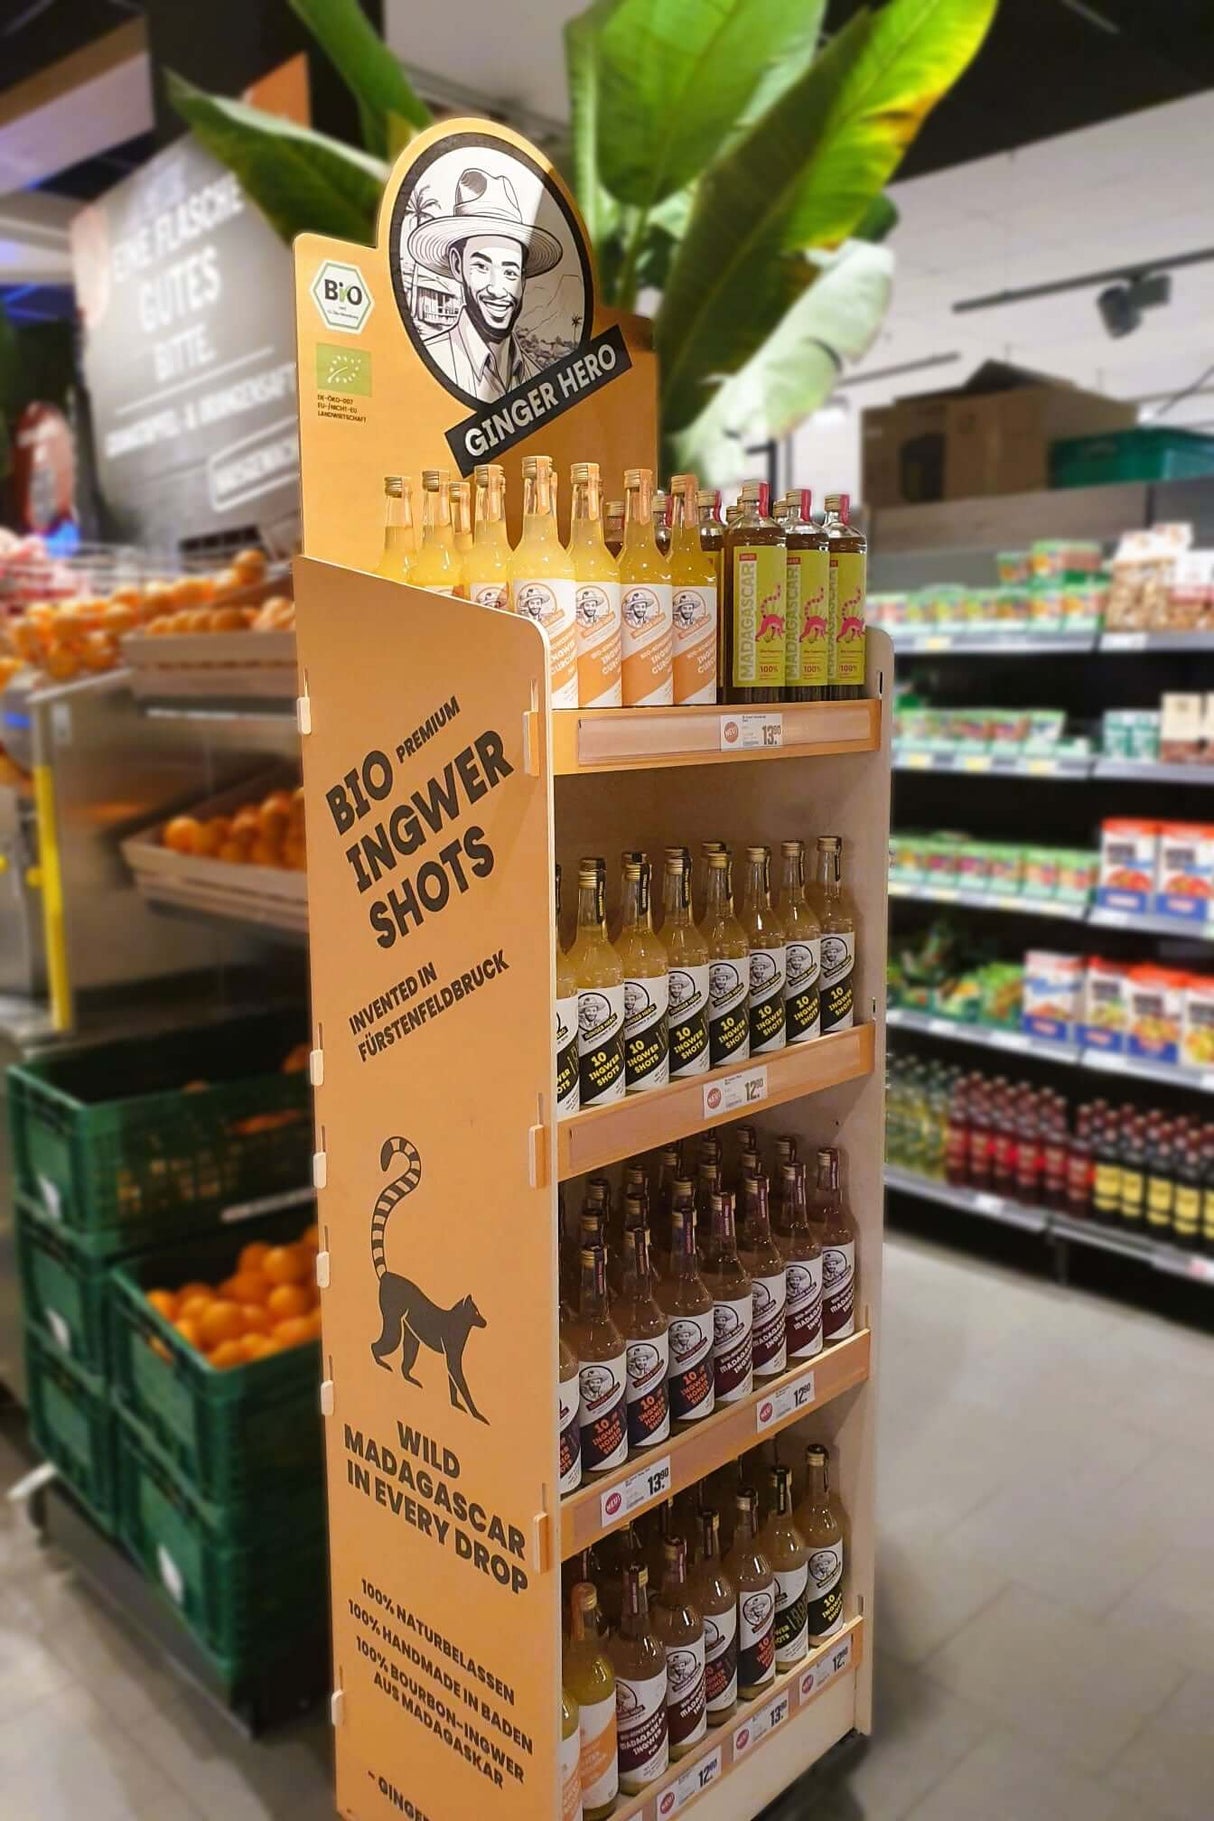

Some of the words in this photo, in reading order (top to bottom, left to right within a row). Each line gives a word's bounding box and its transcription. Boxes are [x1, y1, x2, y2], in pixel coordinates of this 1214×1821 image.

[464, 382, 559, 456] GINGER
[556, 343, 617, 399] HERO
[317, 411, 367, 423] LANDWIRTSCHAFT
[741, 563, 754, 678] MADAGASCAR
[760, 665, 778, 673] 100%
[325, 750, 394, 835] BIO
[396, 695, 460, 763] PREMIUM
[346, 730, 515, 894] INGWER
[370, 826, 495, 949] SHOTS
[349, 976, 418, 1035] INVENTED
[417, 962, 438, 989] IN
[796, 996, 809, 1009] 10
[830, 986, 844, 999] 10
[357, 949, 510, 1063] FÜRSTENFELDBRUCK
[758, 1005, 772, 1019] 10
[676, 1027, 691, 1041] 10
[720, 1017, 735, 1031] 10
[629, 1040, 645, 1054] 10
[674, 1029, 703, 1053] INGWER
[681, 1040, 703, 1060] SHOTS
[588, 1054, 620, 1080] INGWER
[591, 1051, 607, 1067] 10
[627, 1043, 659, 1067] INGWER
[634, 1053, 659, 1074] SHOTS
[596, 1065, 620, 1086] SHOTS
[683, 1371, 697, 1385] 10
[640, 1396, 655, 1410] 10
[594, 1419, 609, 1433] 10
[397, 1420, 460, 1479] WILD
[344, 1423, 526, 1561] MADAGASCAR
[347, 1459, 370, 1496] IN
[375, 1477, 450, 1545] EVERY
[455, 1527, 528, 1594] DROP
[824, 1594, 835, 1608] 10
[361, 1578, 394, 1615] 100%
[396, 1604, 515, 1706] NATURBELASSEN
[348, 1599, 381, 1635] 100%
[382, 1625, 461, 1698] HANDMADE
[463, 1688, 479, 1713] IN
[481, 1703, 533, 1755] BADEN
[356, 1635, 389, 1673] 100%
[390, 1663, 525, 1784] BOURBON-INGWER
[373, 1671, 400, 1704] AUS
[402, 1692, 504, 1788] MADAGASKAR
